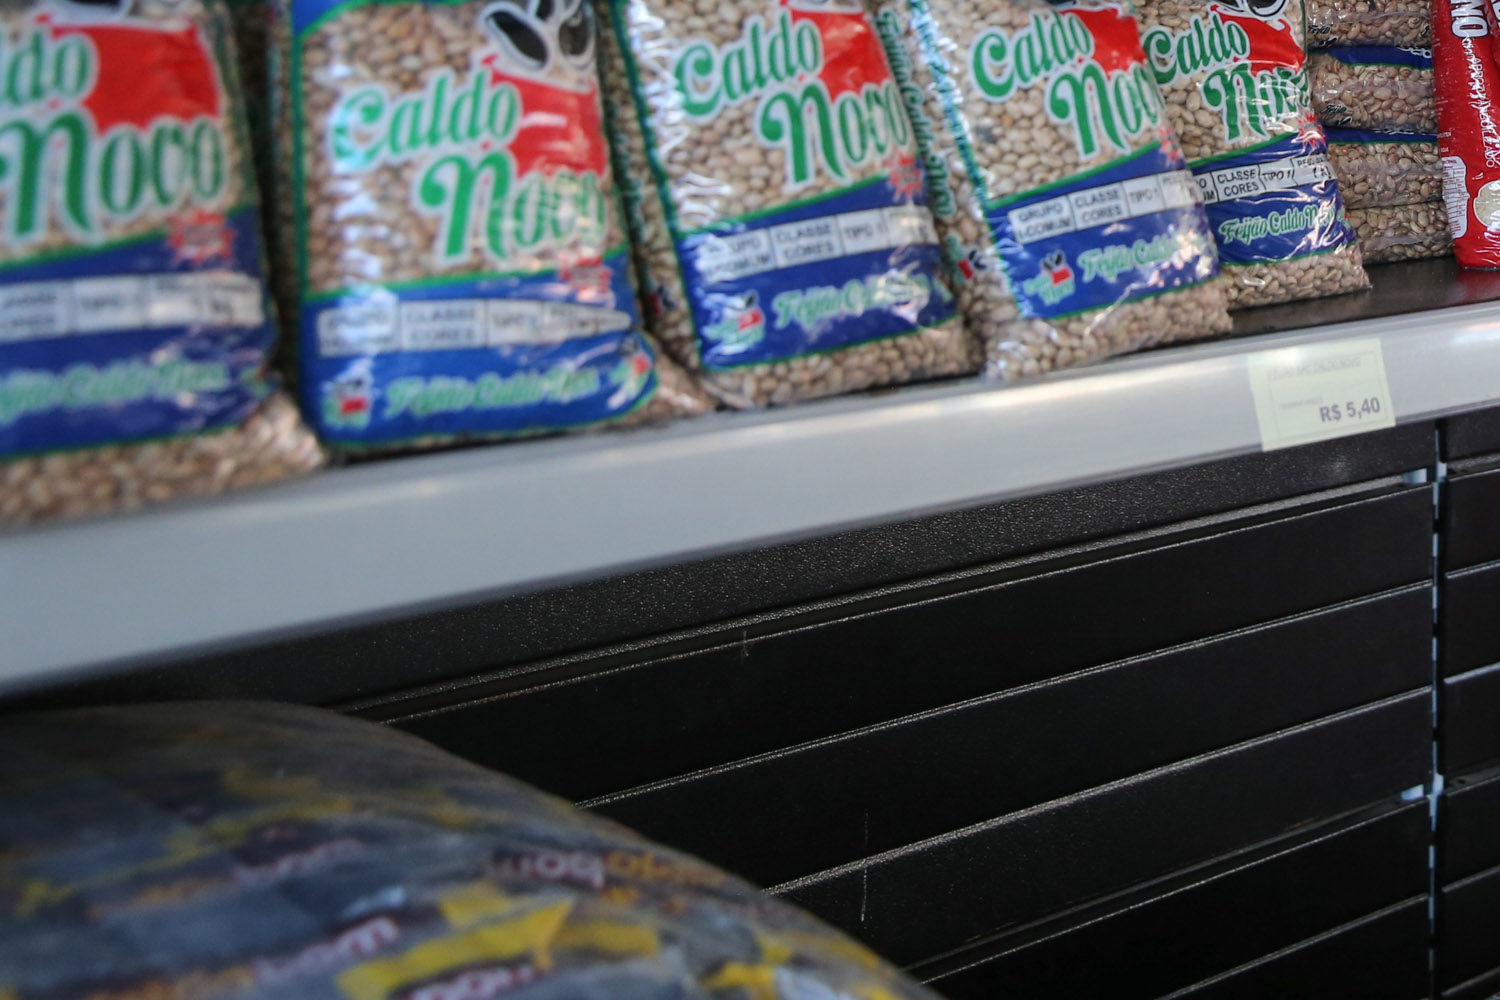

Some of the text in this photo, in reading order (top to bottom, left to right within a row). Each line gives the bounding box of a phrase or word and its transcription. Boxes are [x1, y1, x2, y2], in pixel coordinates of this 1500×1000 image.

[671, 8, 824, 119] Caldo
[970, 10, 1095, 103] Caldo
[1142, 12, 1249, 88] Caldo
[329, 67, 522, 172] Caldo
[1216, 168, 1258, 186] CLASSE
[1223, 181, 1260, 197] CORES
[1074, 188, 1121, 208] CLASSE
[1080, 204, 1124, 223] CORES
[1218, 215, 1269, 246] Feijão
[1268, 207, 1306, 235] Caldo
[1319, 396, 1382, 423] R$ 5,40
